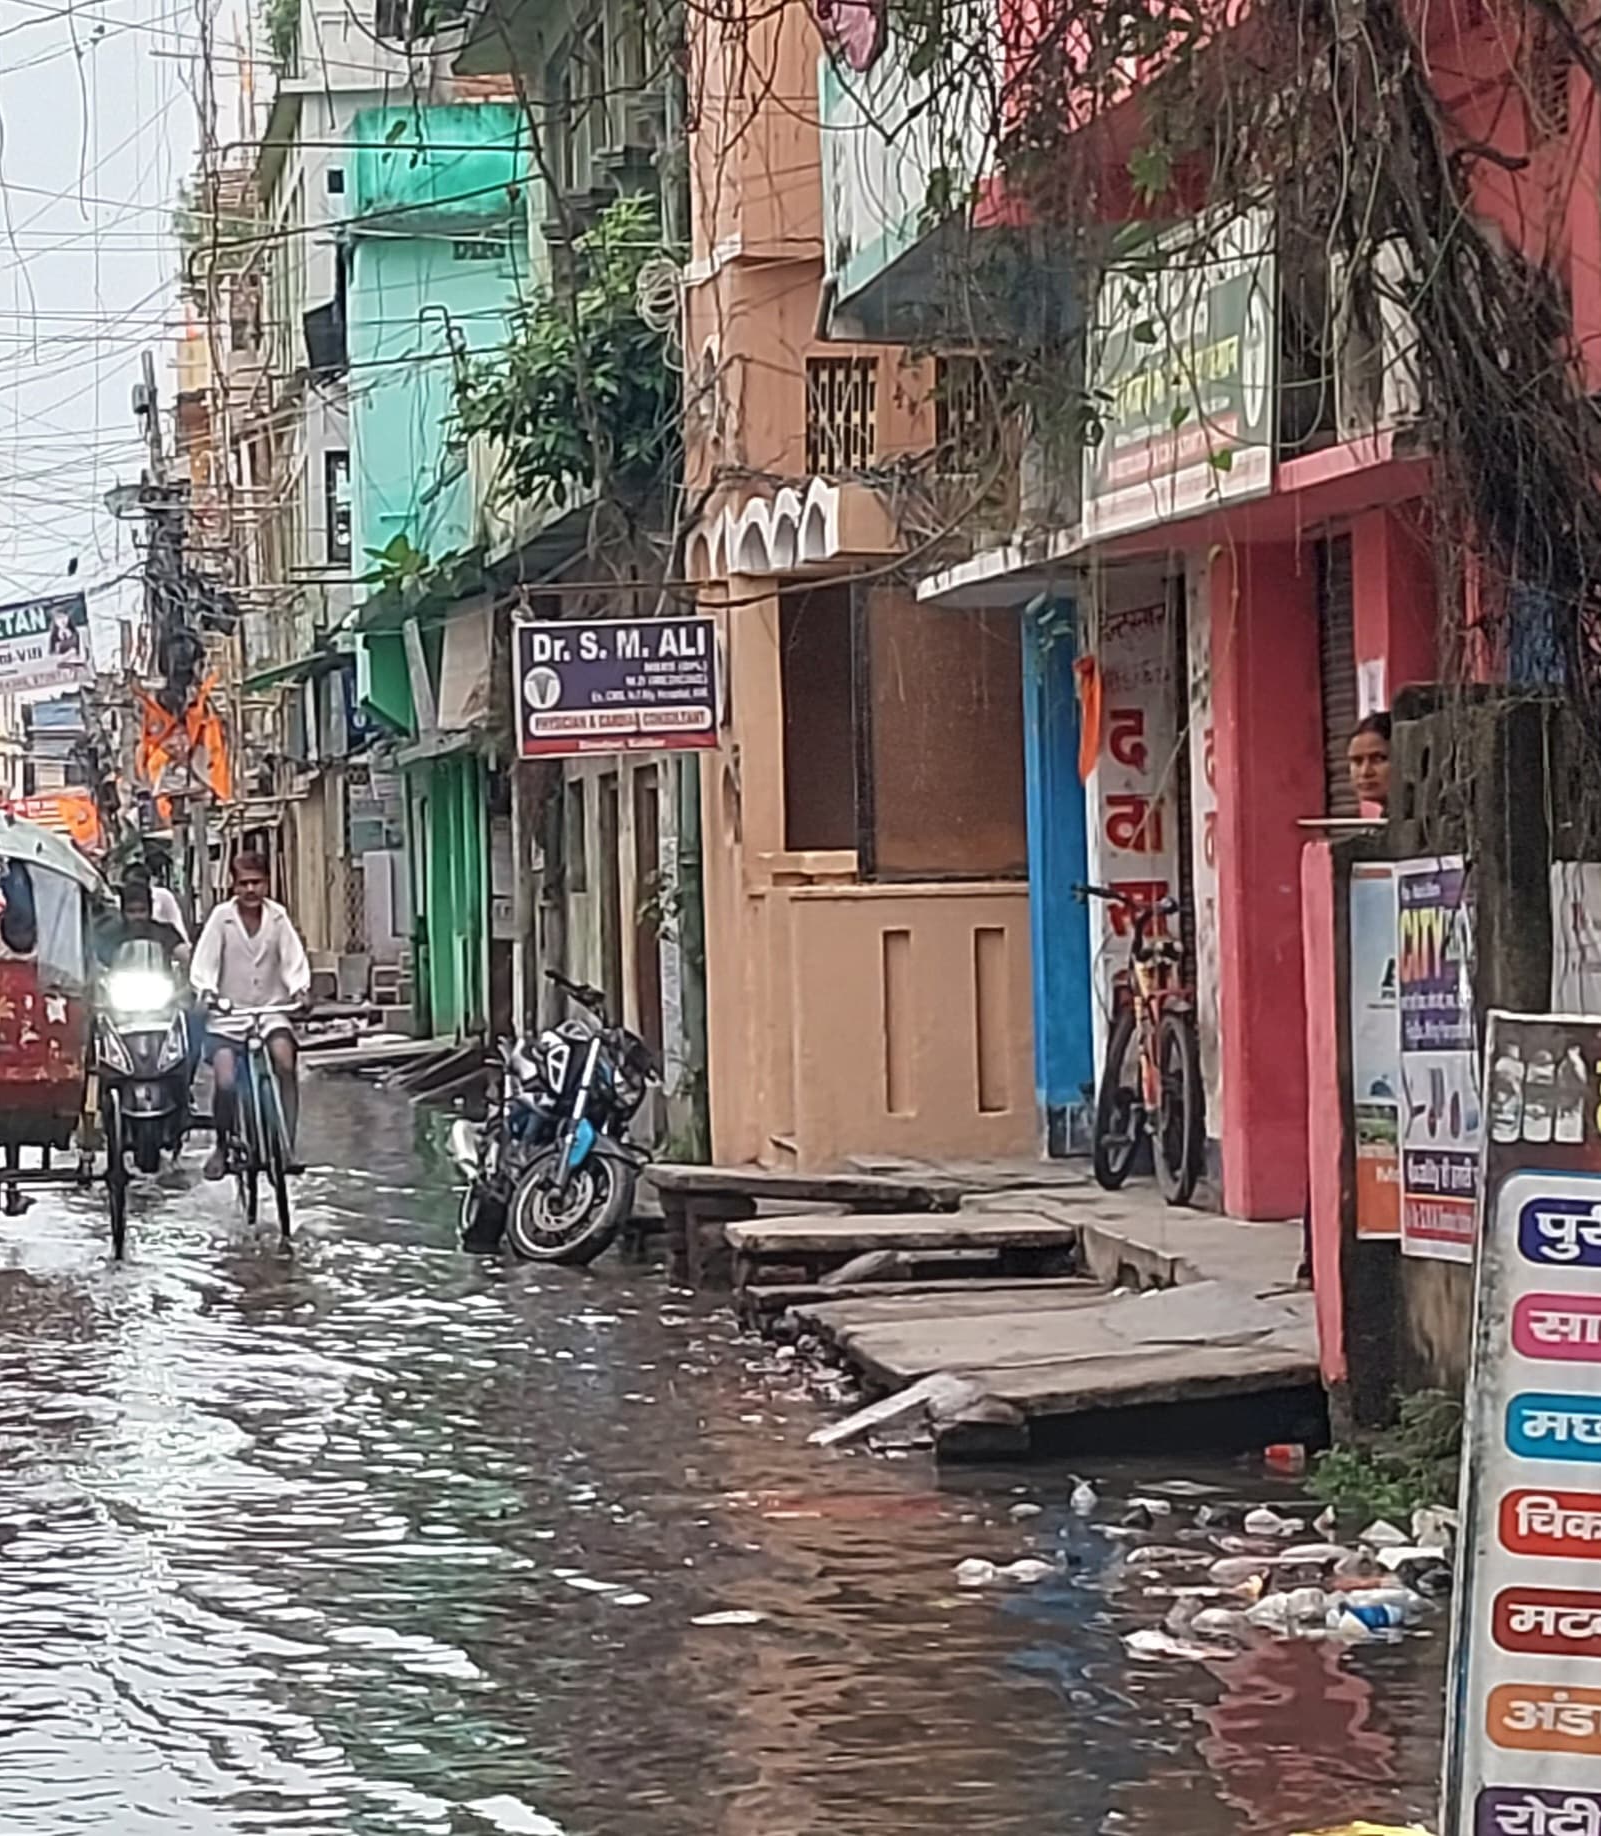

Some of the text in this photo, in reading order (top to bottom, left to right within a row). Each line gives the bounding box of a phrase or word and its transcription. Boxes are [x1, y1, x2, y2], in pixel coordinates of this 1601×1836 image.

[532, 626, 707, 663] Dr. S. M. ALI
[1527, 1309, 1601, 1344] सा
[1520, 1409, 1601, 1444] मछ
[1515, 1495, 1601, 1541] चिक
[1507, 1603, 1601, 1639] मट
[1502, 1690, 1601, 1737] अंड
